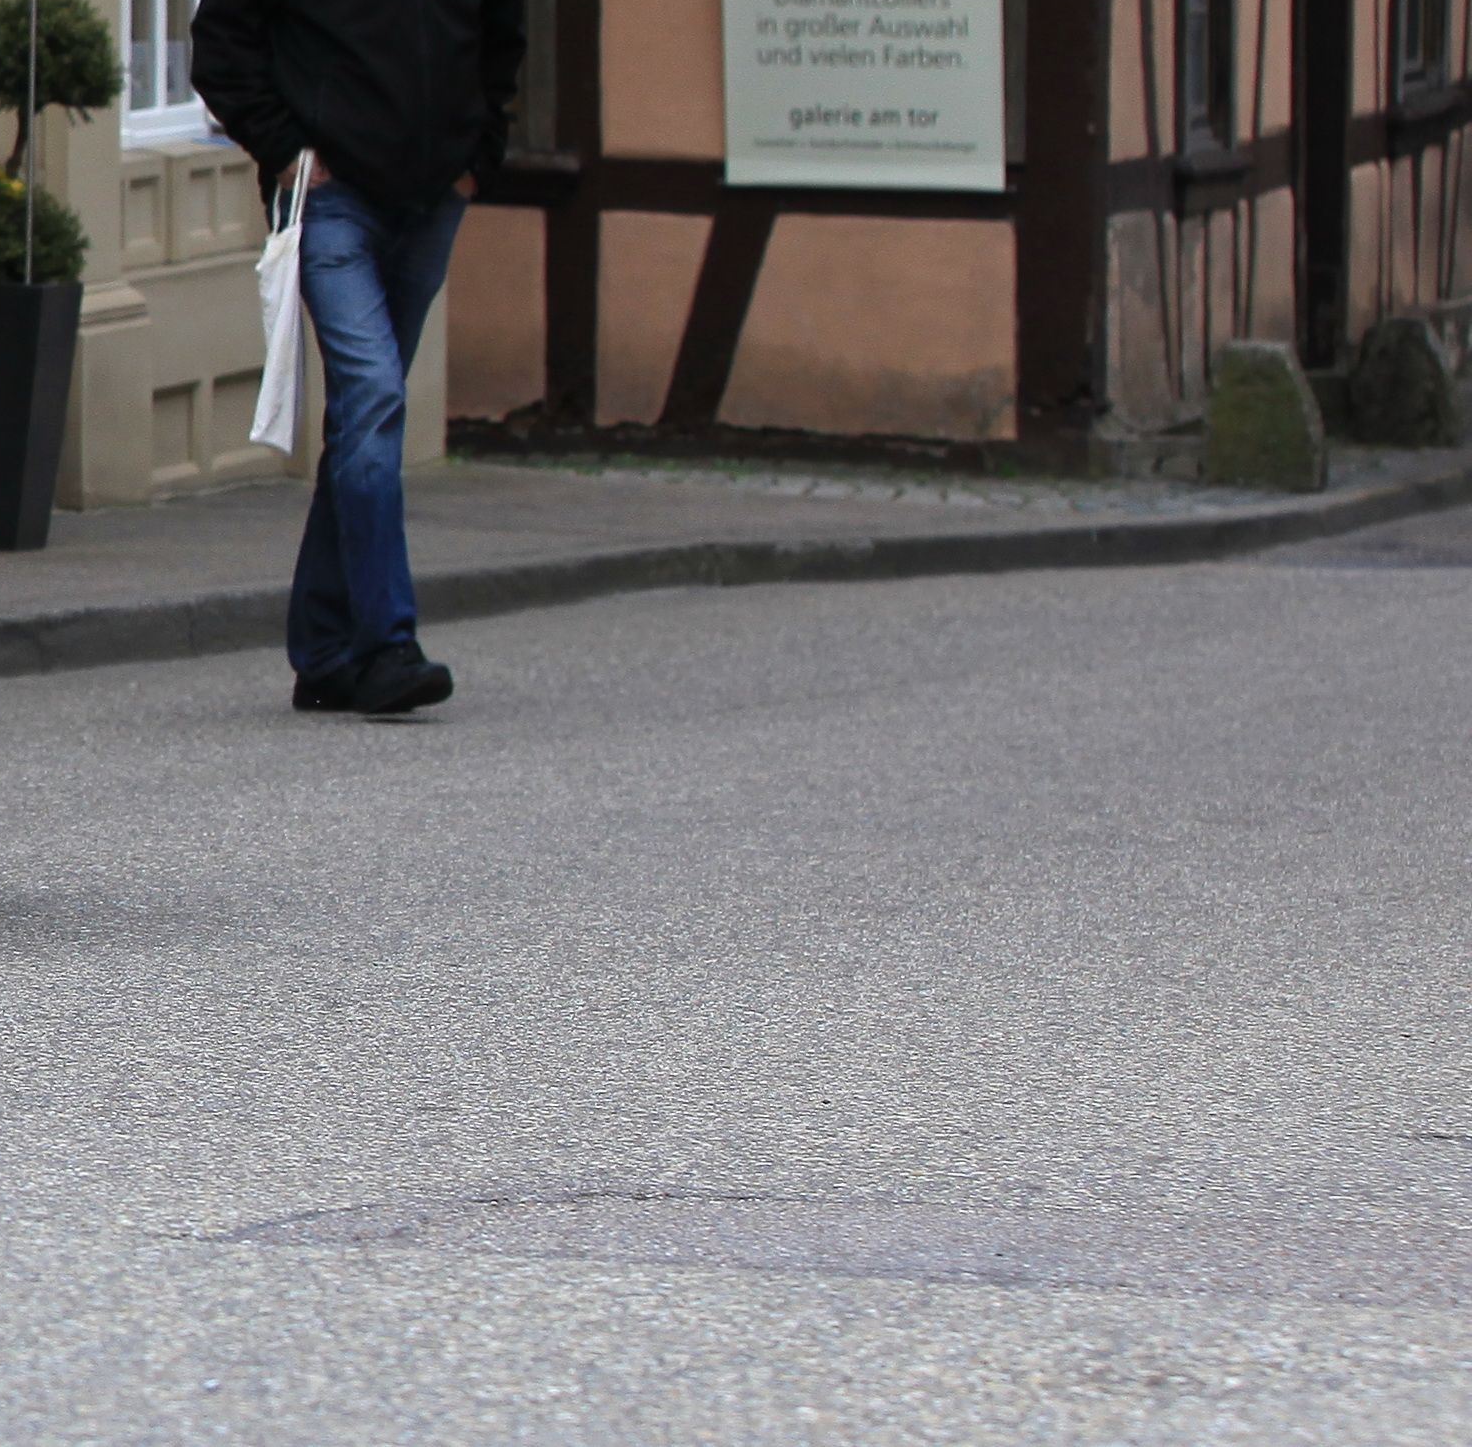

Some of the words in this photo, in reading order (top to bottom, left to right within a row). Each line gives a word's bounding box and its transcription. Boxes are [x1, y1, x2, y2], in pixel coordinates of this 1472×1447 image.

[757, 16, 777, 35] in
[869, 14, 969, 37] Auswahl
[757, 44, 802, 66] und
[809, 43, 875, 68] vielen
[789, 103, 862, 130] galerie
[869, 108, 901, 126] am
[908, 107, 939, 128] tor
